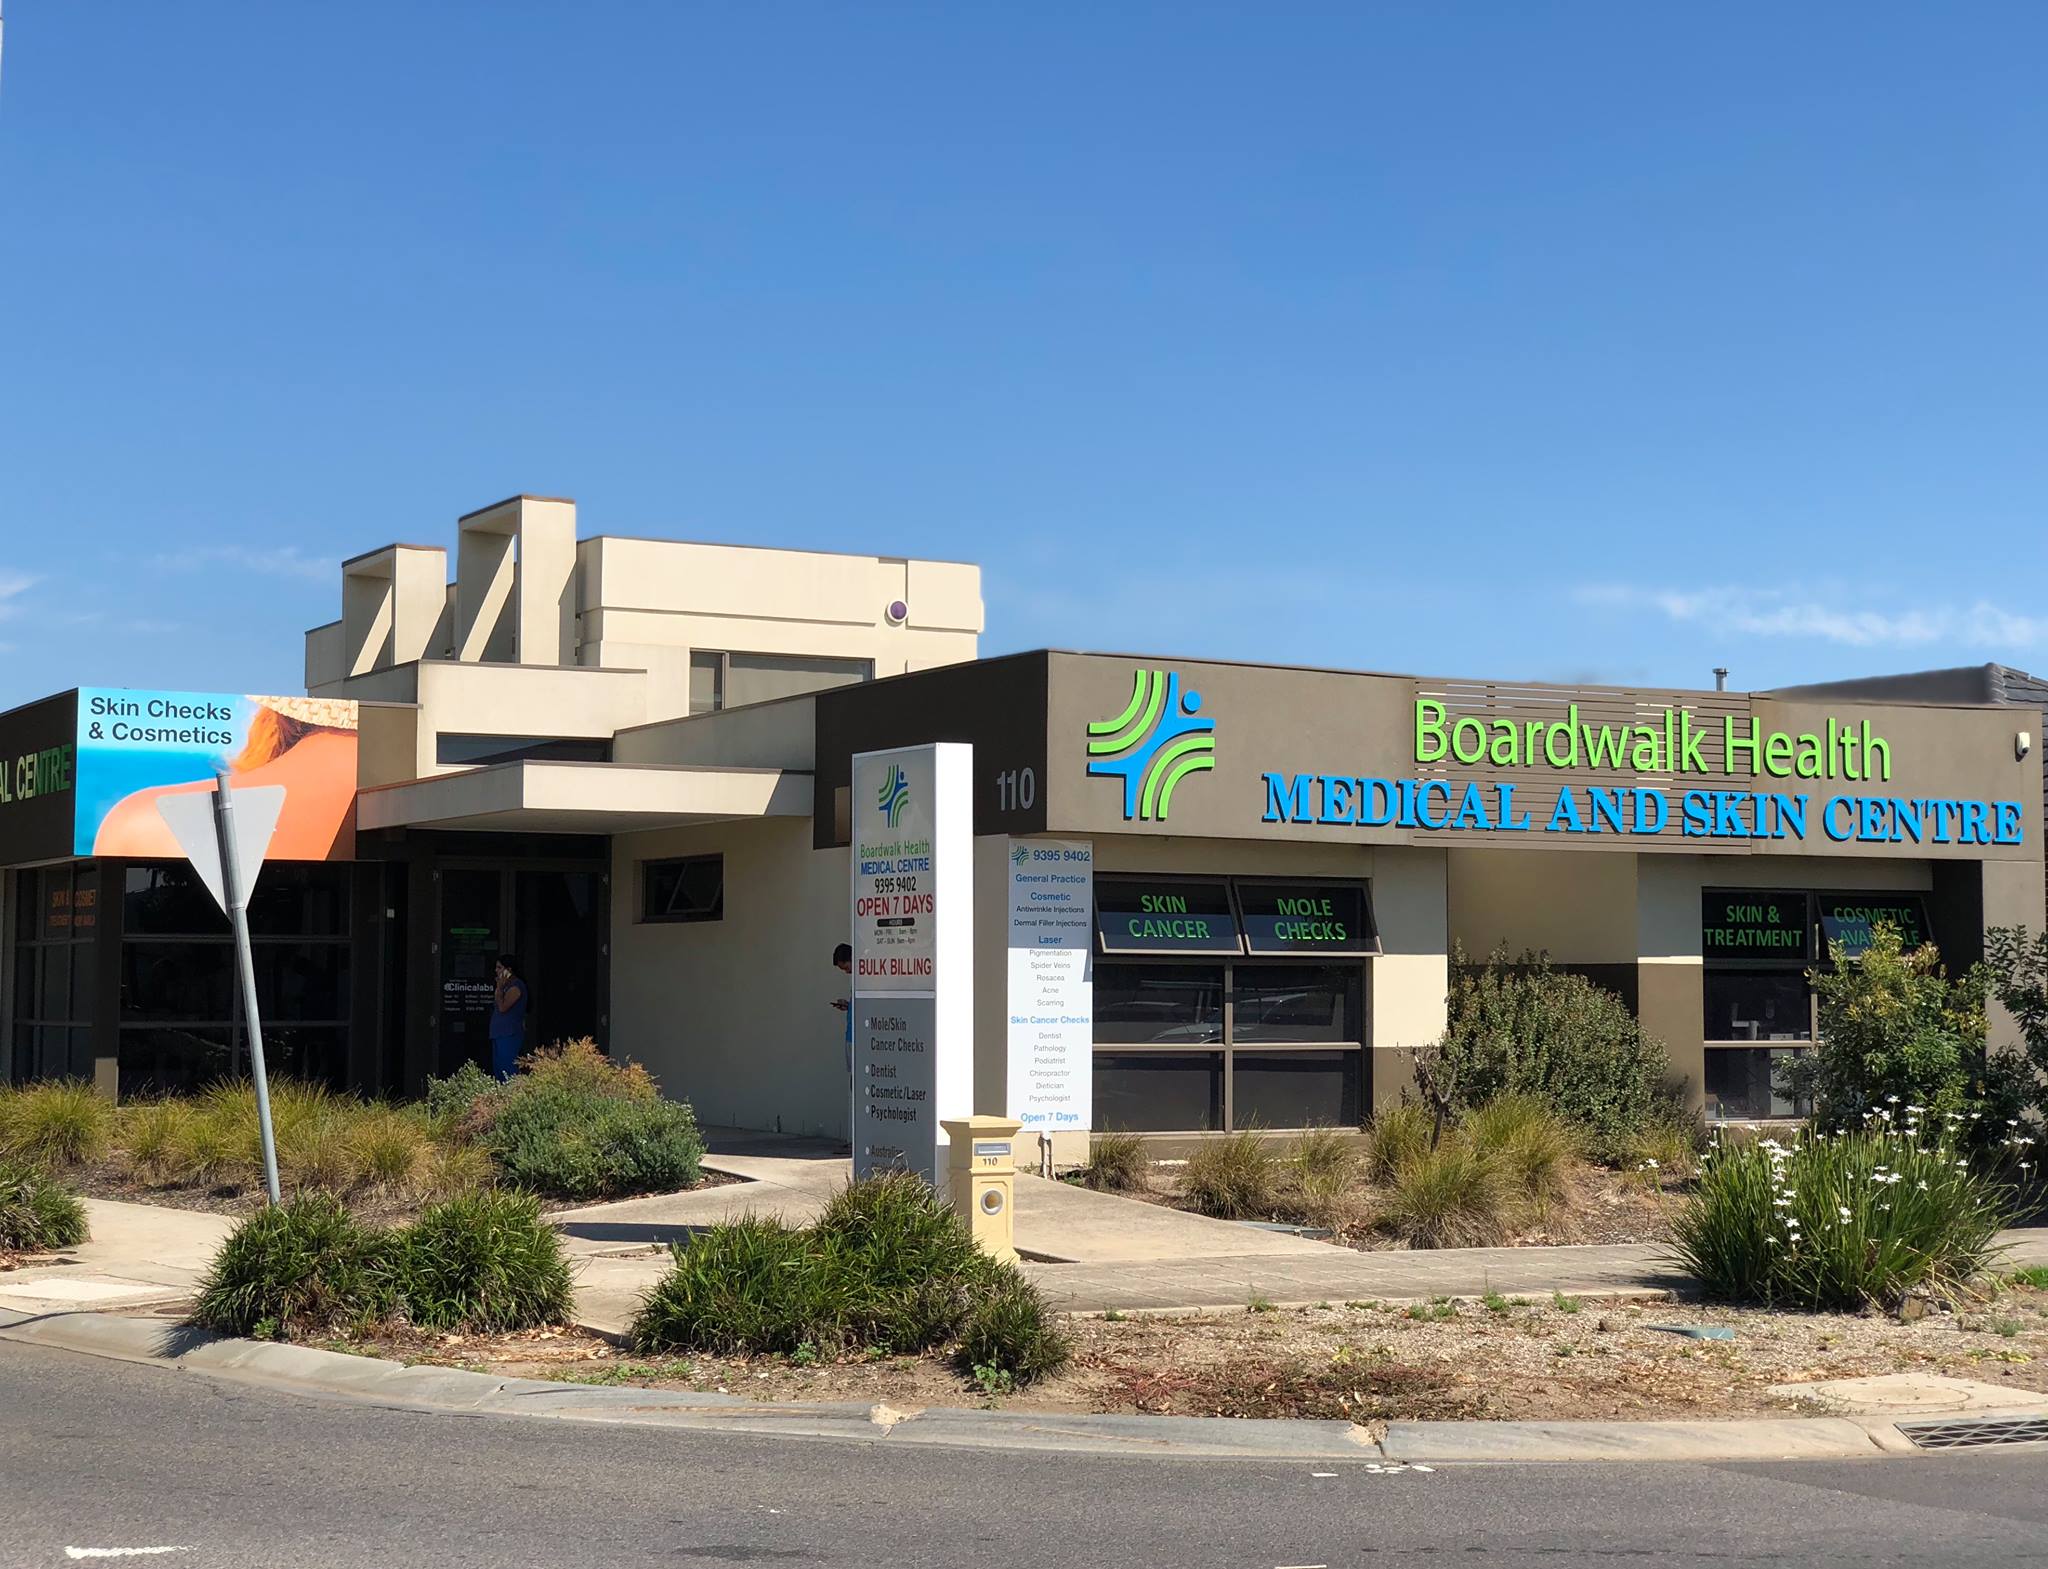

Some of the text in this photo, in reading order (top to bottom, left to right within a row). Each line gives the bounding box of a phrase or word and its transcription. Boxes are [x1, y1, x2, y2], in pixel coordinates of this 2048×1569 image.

[90, 697, 232, 721] Skin Checks
[88, 722, 232, 745] & Cosmetics
[1415, 698, 1892, 781] Boardwalk Health
[16, 744, 73, 801] CENTRE
[996, 767, 1035, 811] 110
[1262, 772, 2024, 846] MEDICAL AND SKIN CENTRE
[860, 839, 930, 859] Boardwalk Health
[1033, 849, 1090, 862] 9395 9402
[860, 857, 930, 876] MEDICAL CENTRE
[874, 876, 917, 894] 9395 9402
[1015, 873, 1086, 884] General Practice
[1030, 892, 1071, 901] Cosmetic
[1140, 895, 1187, 914] SKIN
[857, 894, 933, 917] OPEN 7 DAYS
[1016, 905, 1085, 915] Antiwrinkle Injections
[1277, 898, 1334, 916] MOLE
[1726, 905, 1781, 924] SKIN &
[1833, 907, 1915, 925] COSMETIC
[1014, 919, 1087, 929] Dermal Filler Injections
[1128, 918, 1211, 939] CANCER
[1274, 921, 1348, 941] CHECKS
[1038, 936, 1063, 944] Laser
[1703, 928, 1803, 947] TREATMENT
[1029, 950, 1072, 958] Pigmentation
[858, 957, 932, 975] BULK BILLING
[1030, 962, 1052, 970] Spider
[1037, 999, 1065, 1007] Scarring
[870, 1016, 907, 1032] Mole/Skin
[1010, 1016, 1090, 1024] Skin Cancer Checks
[870, 1037, 924, 1053] Cancer Checks
[1033, 1045, 1067, 1053] Pathology
[870, 1063, 897, 1079] Dentist
[1029, 1070, 1070, 1078] Chiropractor
[870, 1084, 926, 1101] Cosmetic/Laser
[1029, 1095, 1071, 1103] Psychologist
[870, 1105, 917, 1123] Psychologist
[1020, 1112, 1079, 1123] Open 7 Days
[982, 1157, 998, 1166] 110
